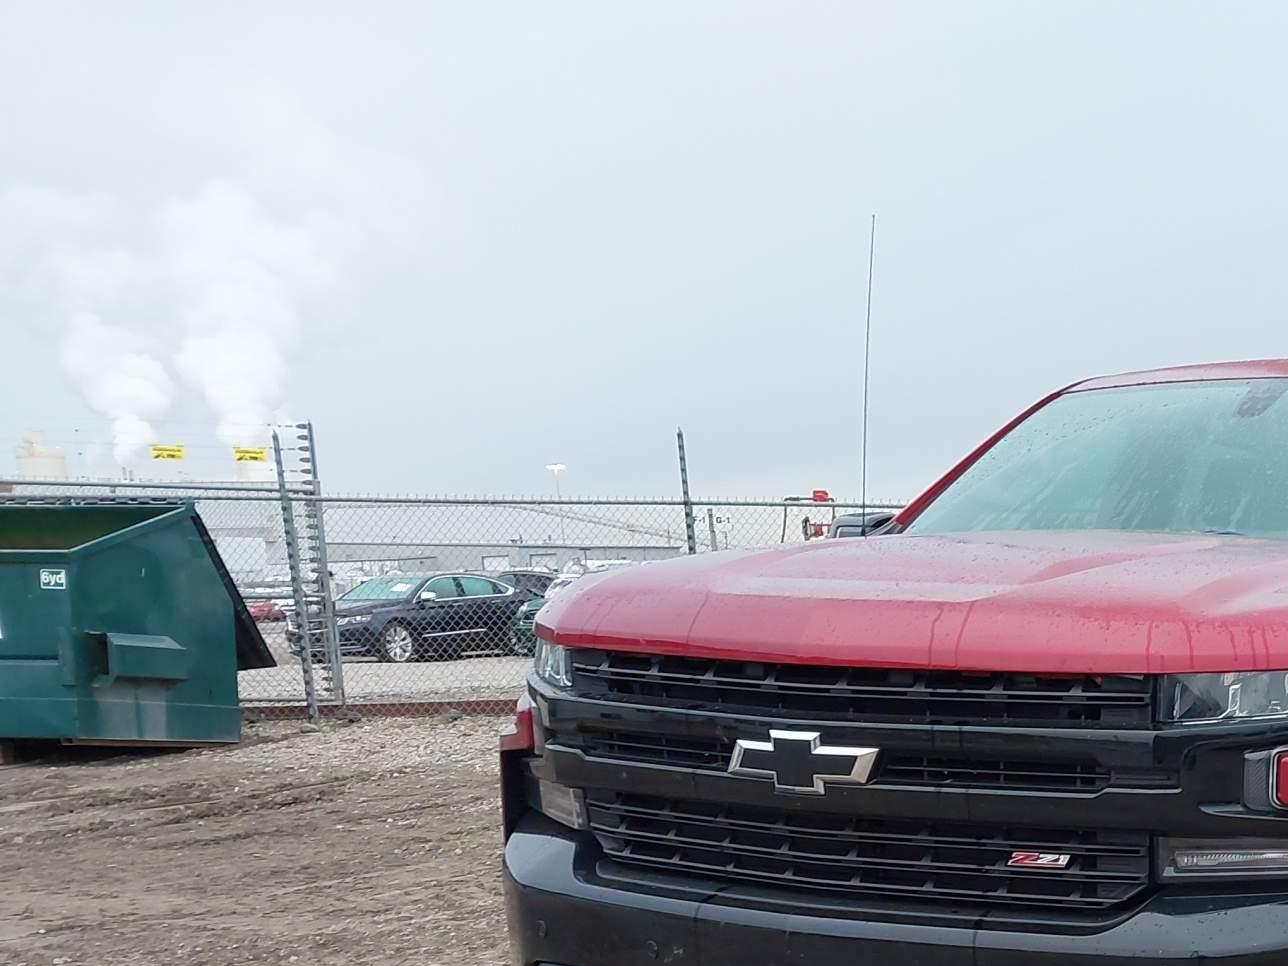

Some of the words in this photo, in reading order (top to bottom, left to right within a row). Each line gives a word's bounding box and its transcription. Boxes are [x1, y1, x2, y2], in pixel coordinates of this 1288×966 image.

[715, 516, 731, 524] G-1
[42, 571, 65, 586] 6yd
[1007, 851, 1071, 868] Z71
